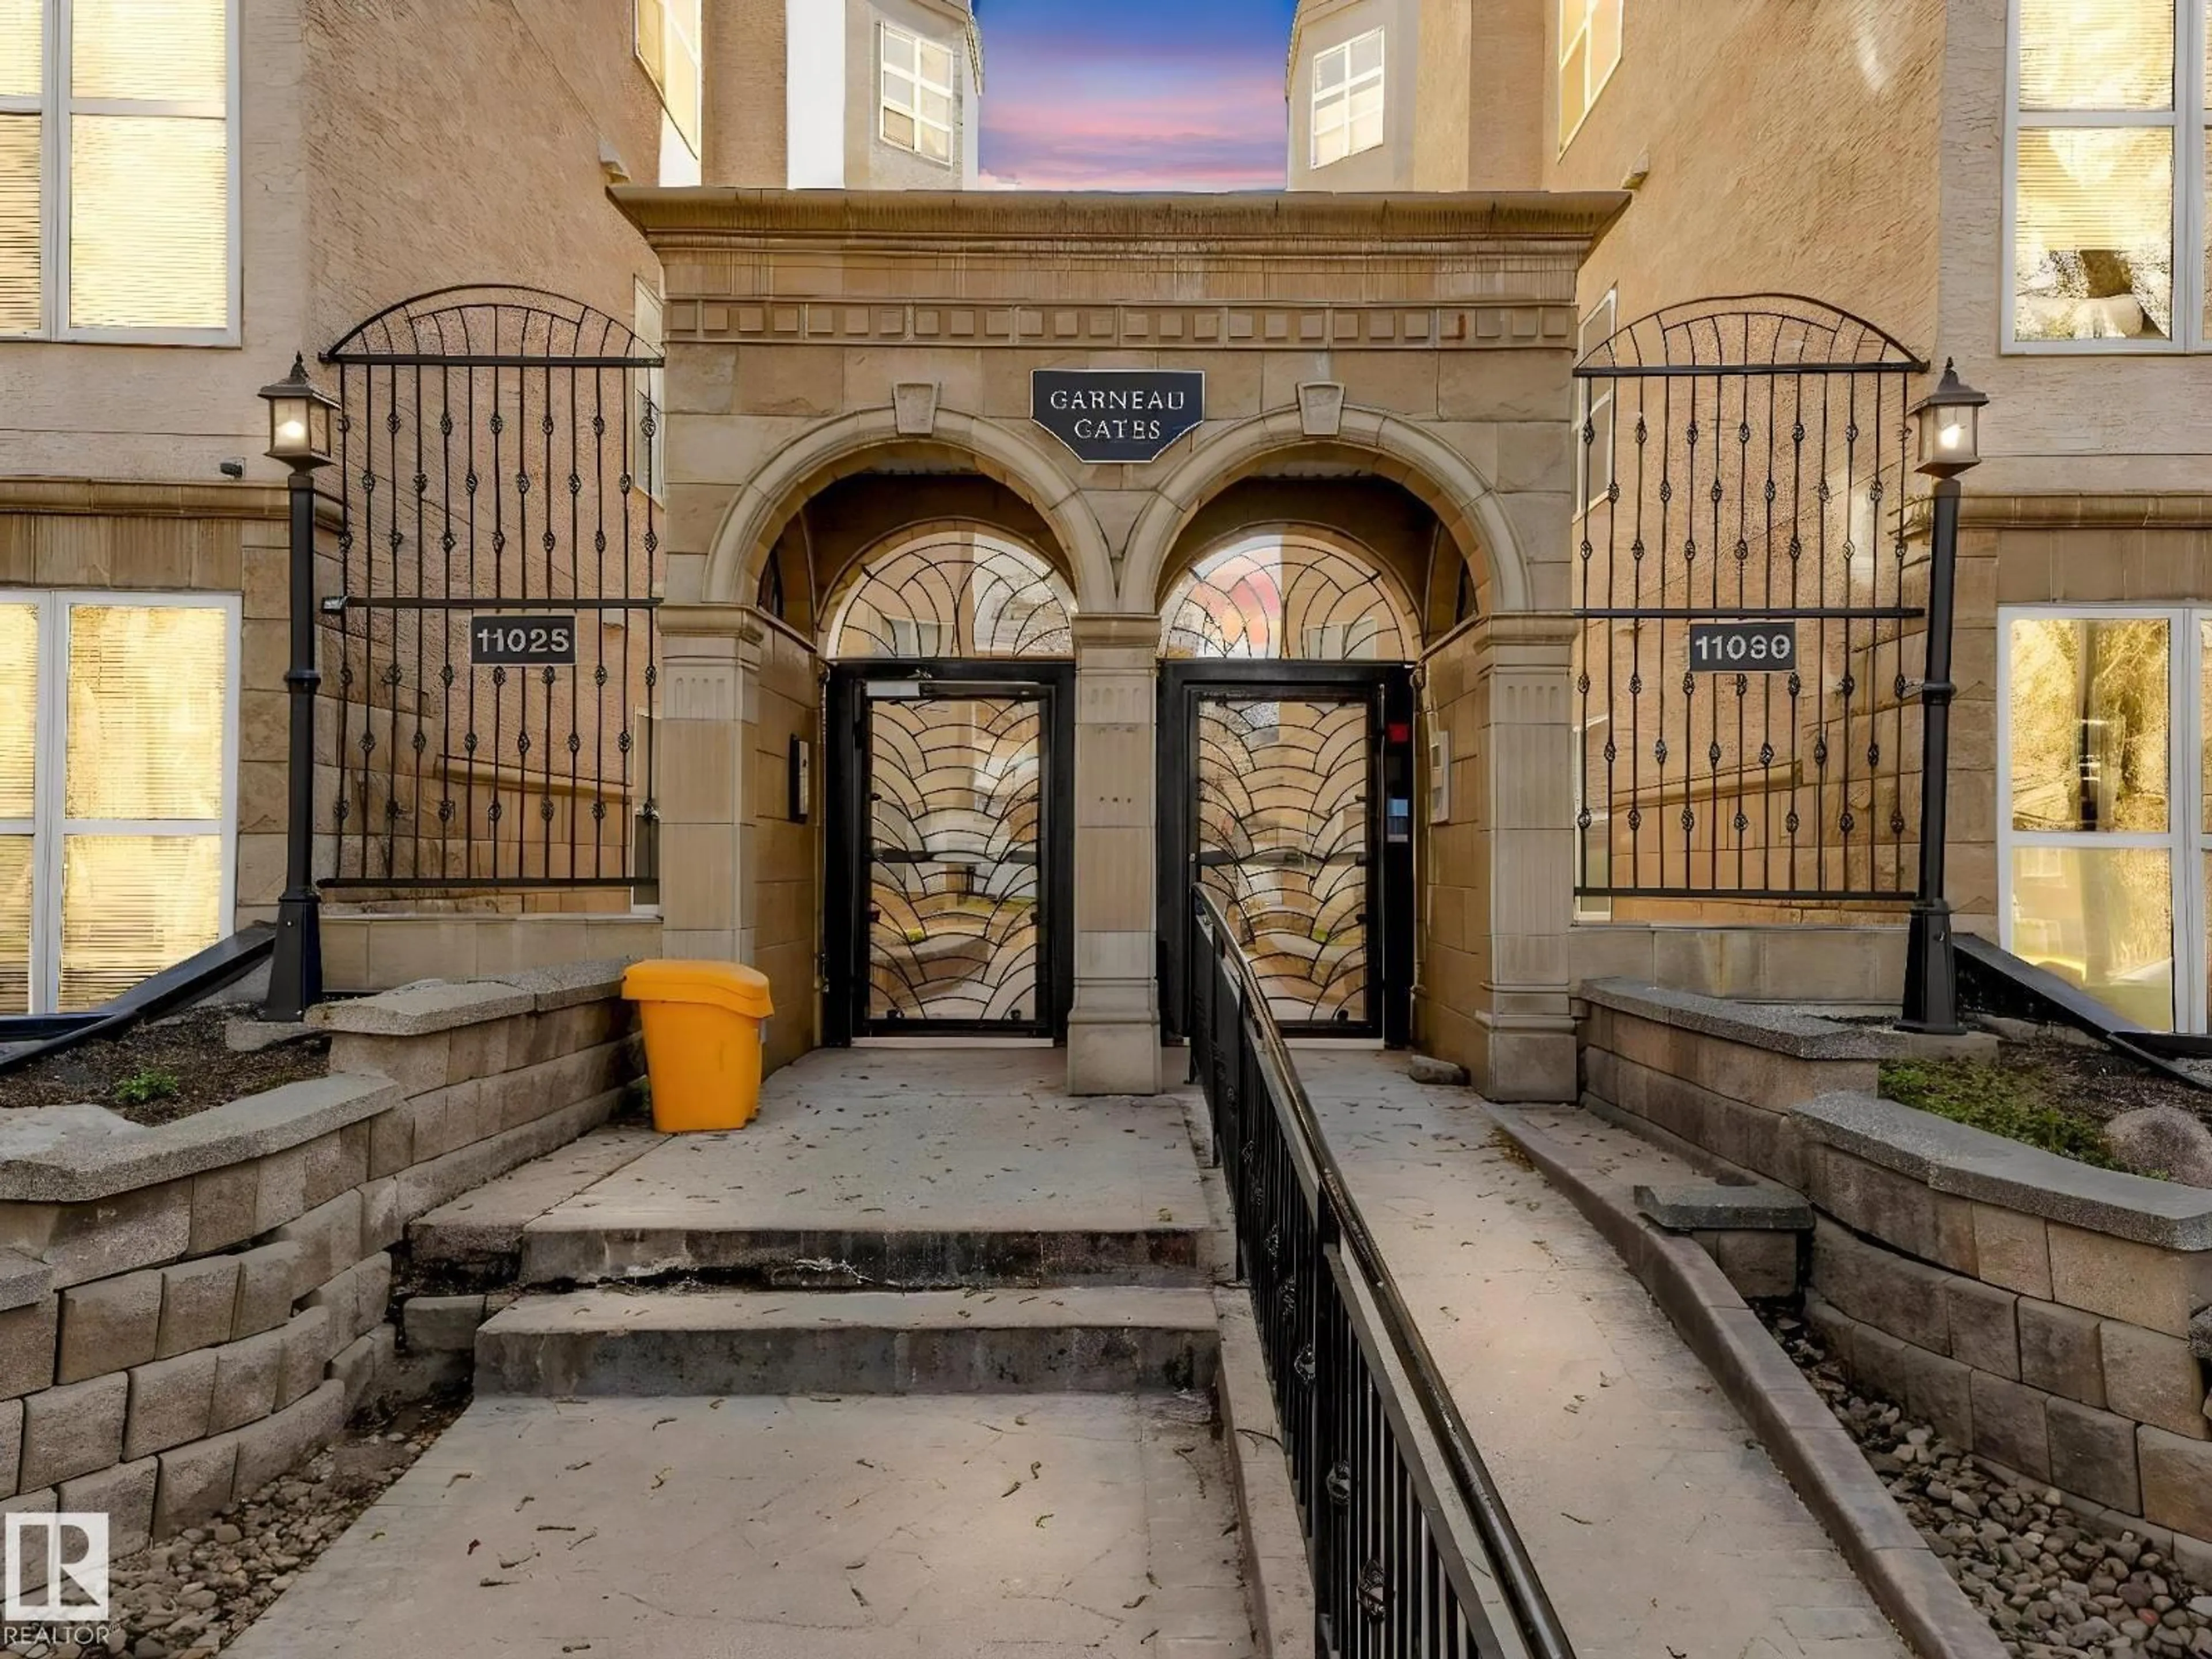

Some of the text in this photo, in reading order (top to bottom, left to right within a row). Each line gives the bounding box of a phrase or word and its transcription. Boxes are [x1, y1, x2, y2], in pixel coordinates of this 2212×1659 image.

[1050, 390, 1184, 410] GARNEAU
[1074, 418, 1160, 439] GATES
[477, 628, 569, 653] 11025
